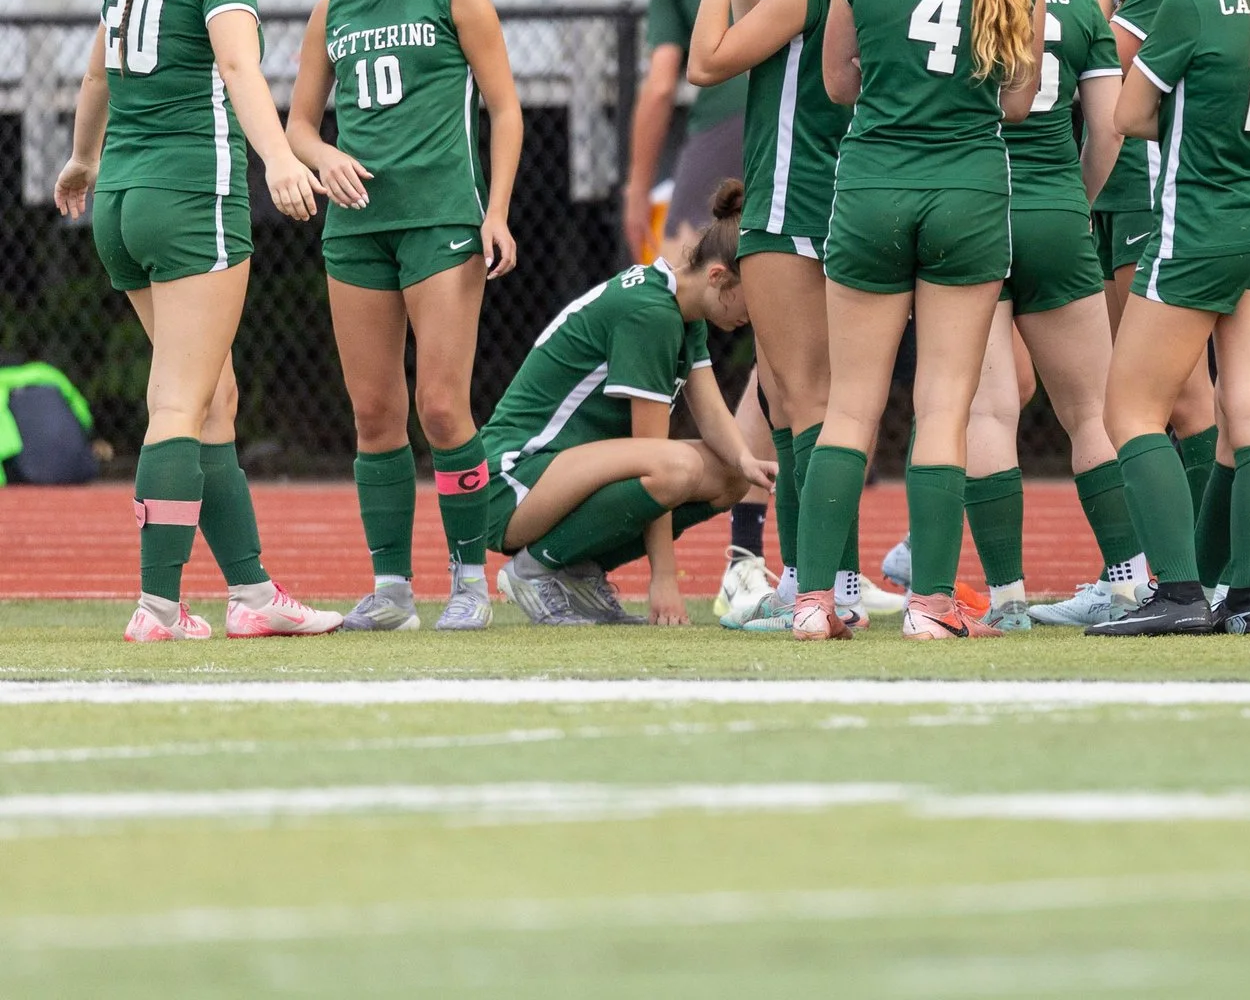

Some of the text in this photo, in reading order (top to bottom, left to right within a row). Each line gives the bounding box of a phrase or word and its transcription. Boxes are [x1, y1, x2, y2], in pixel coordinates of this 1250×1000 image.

[327, 22, 436, 63] KETTERING
[355, 55, 403, 110] 10
[458, 470, 481, 490] C
